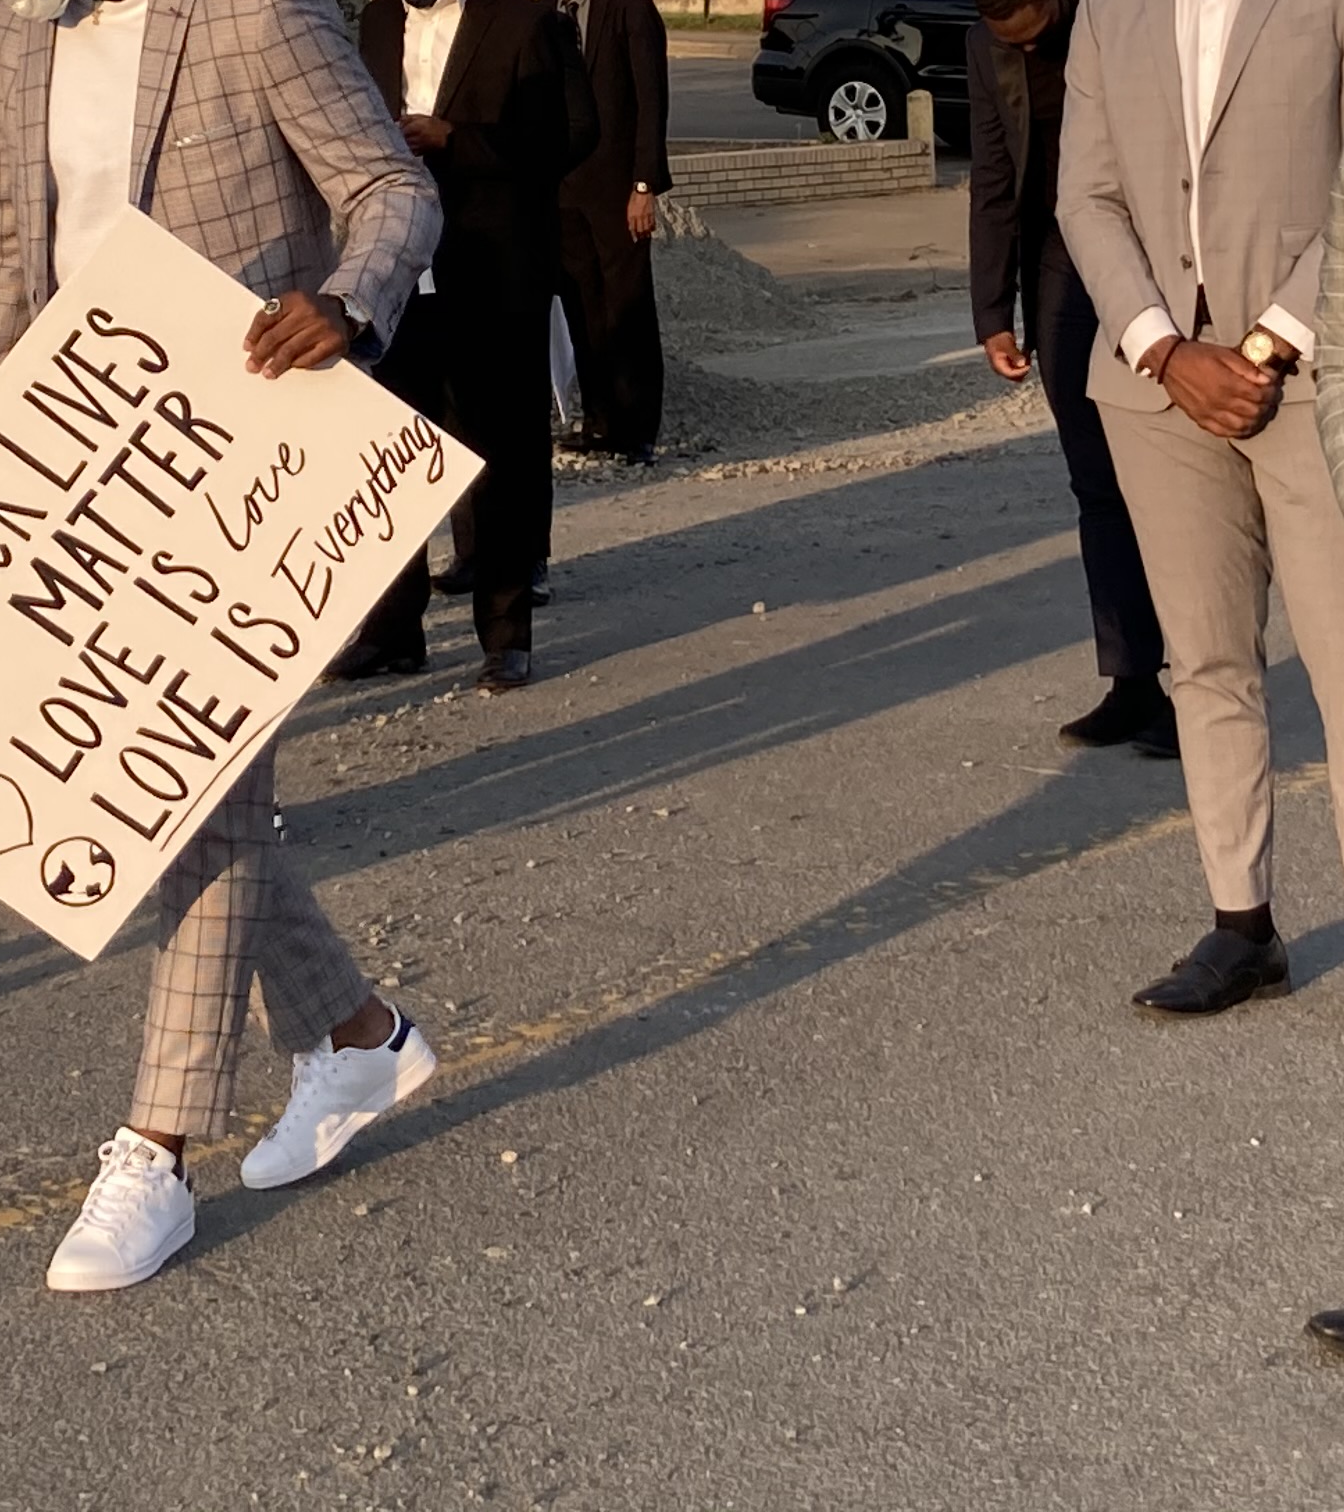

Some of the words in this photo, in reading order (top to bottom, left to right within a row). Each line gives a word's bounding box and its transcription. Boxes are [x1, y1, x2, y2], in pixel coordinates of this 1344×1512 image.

[7, 390, 235, 647] MATTER
[9, 621, 167, 784] LOVE
[133, 549, 220, 626] IS
[204, 441, 306, 552] Love
[89, 669, 253, 842] LOVE
[210, 601, 300, 682] IS
[270, 414, 445, 620] Everything
